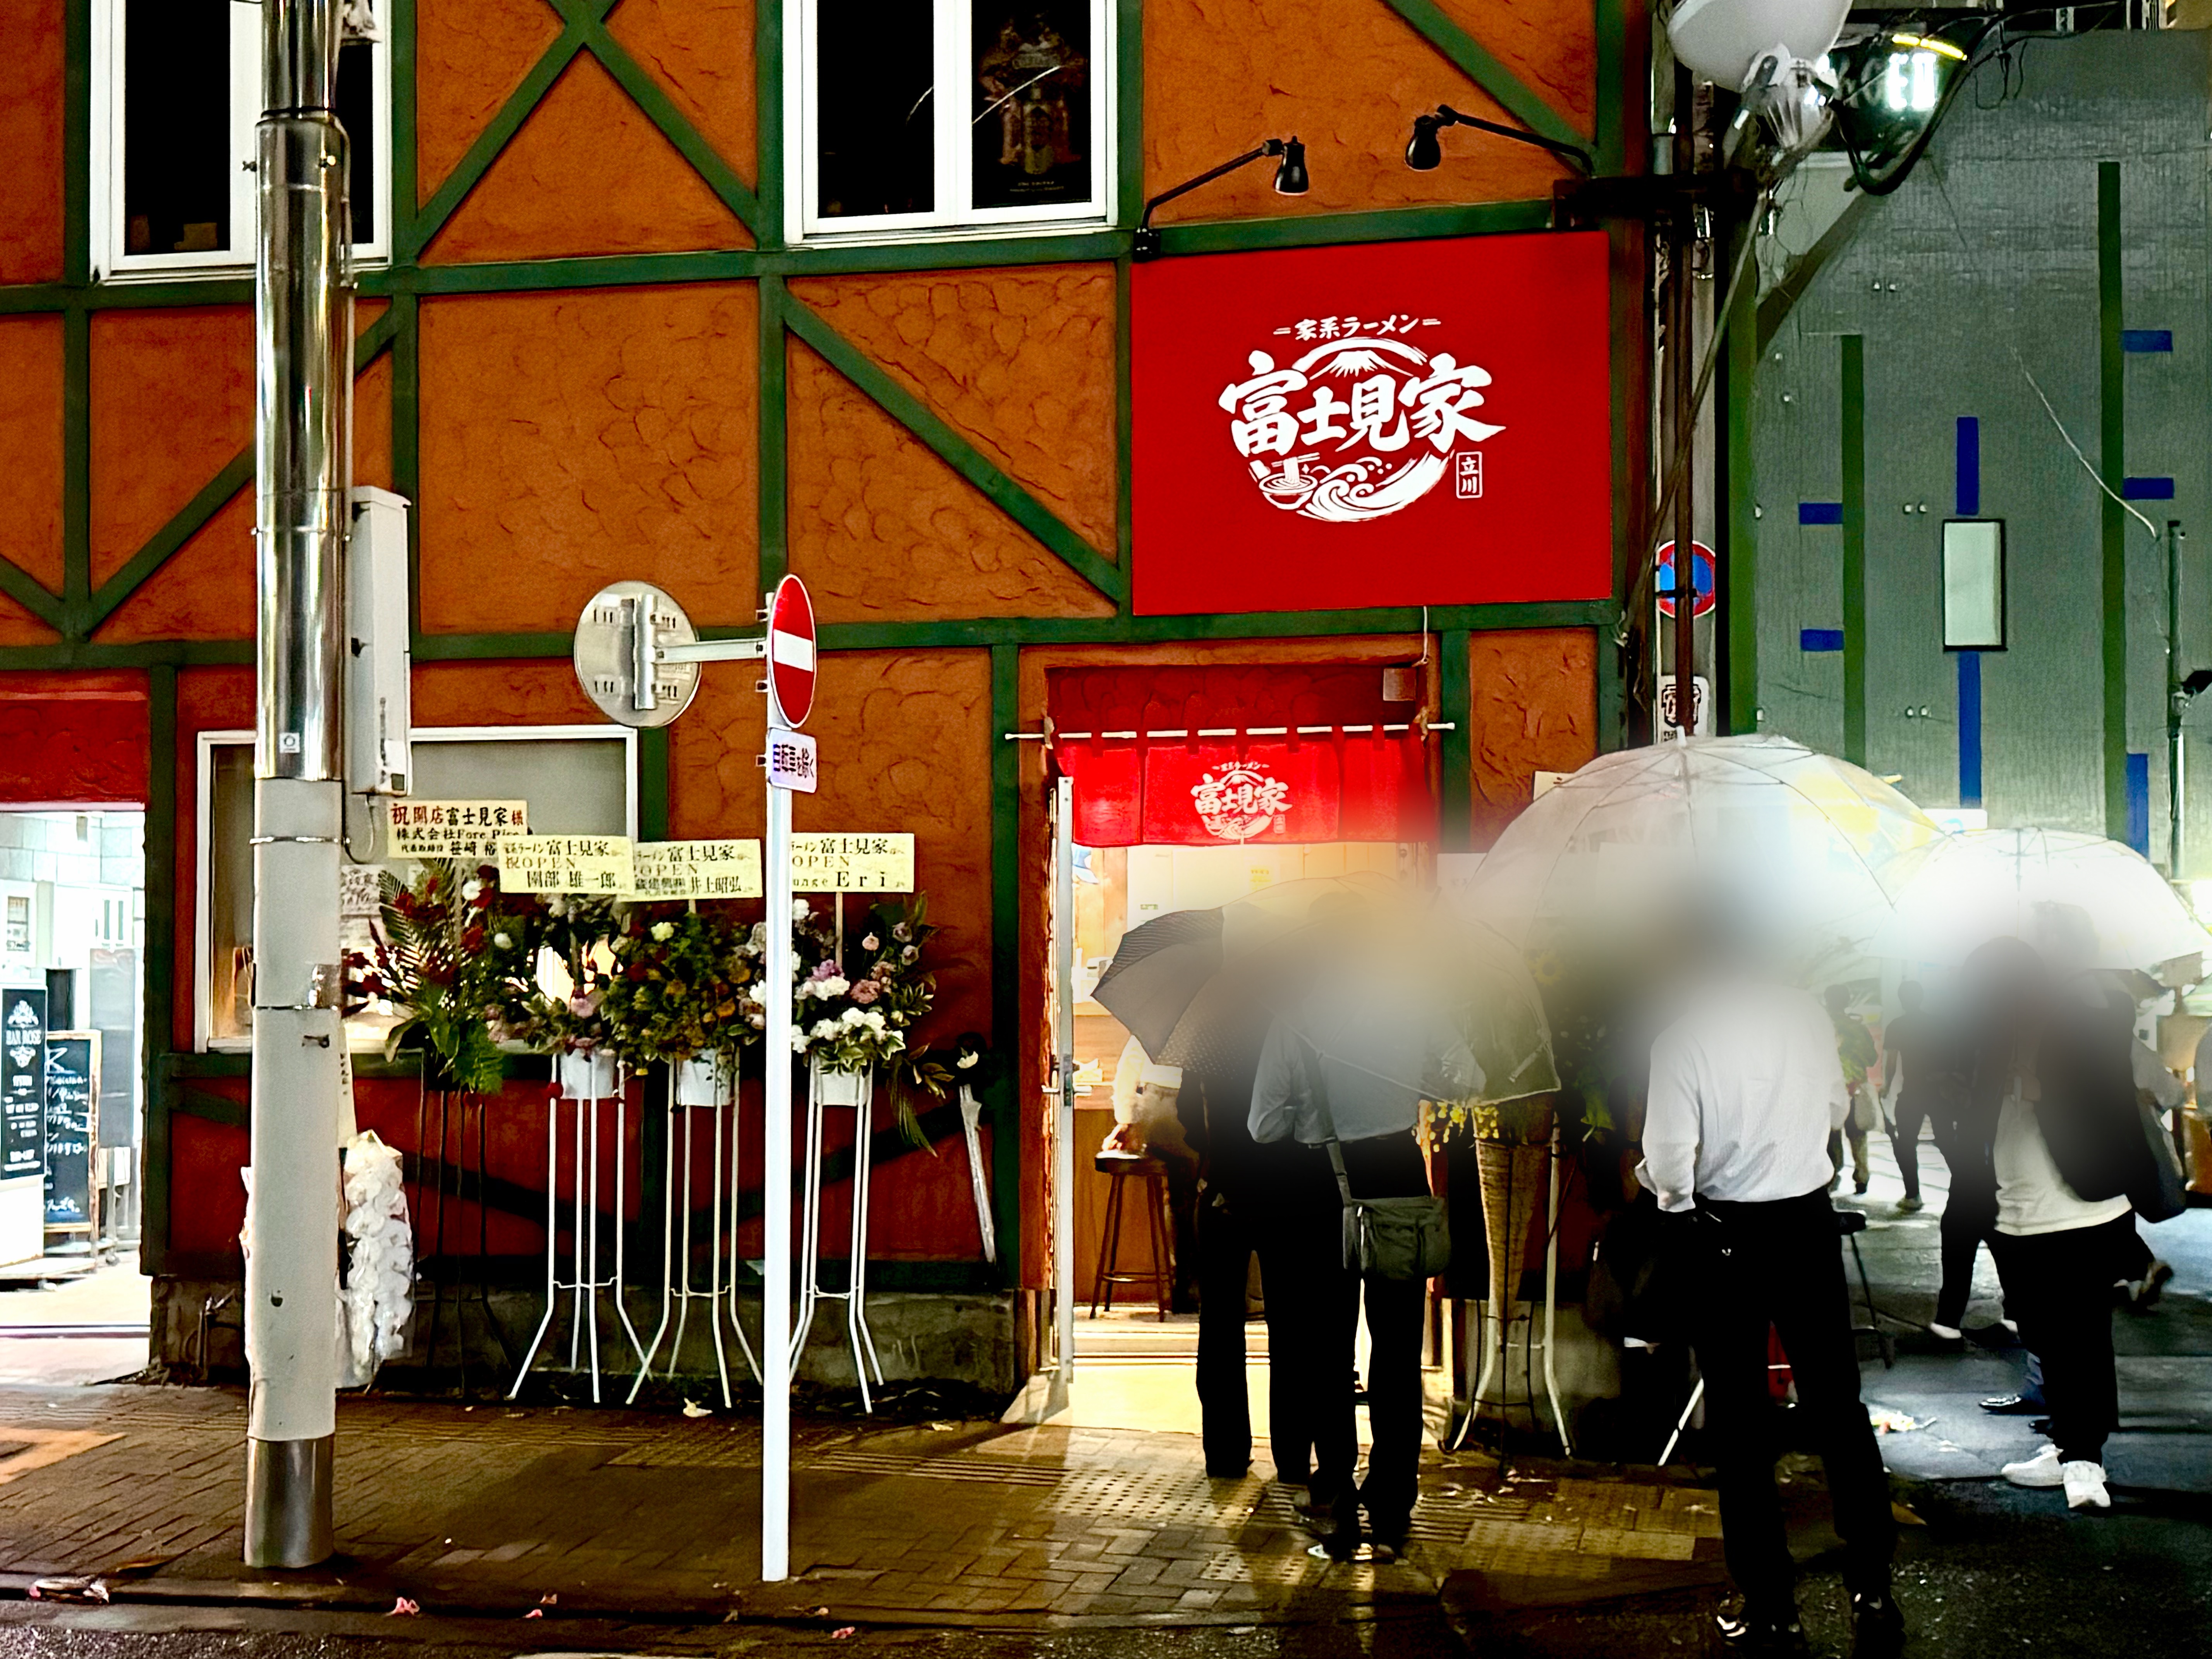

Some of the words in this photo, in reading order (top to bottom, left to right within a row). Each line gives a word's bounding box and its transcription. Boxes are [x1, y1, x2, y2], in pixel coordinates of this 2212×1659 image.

[1295, 314, 1419, 341] 家系ラーメン
[1218, 350, 1506, 458] 富士見家
[1460, 457, 1479, 493] 立川
[1190, 773, 1293, 815] 富士見家
